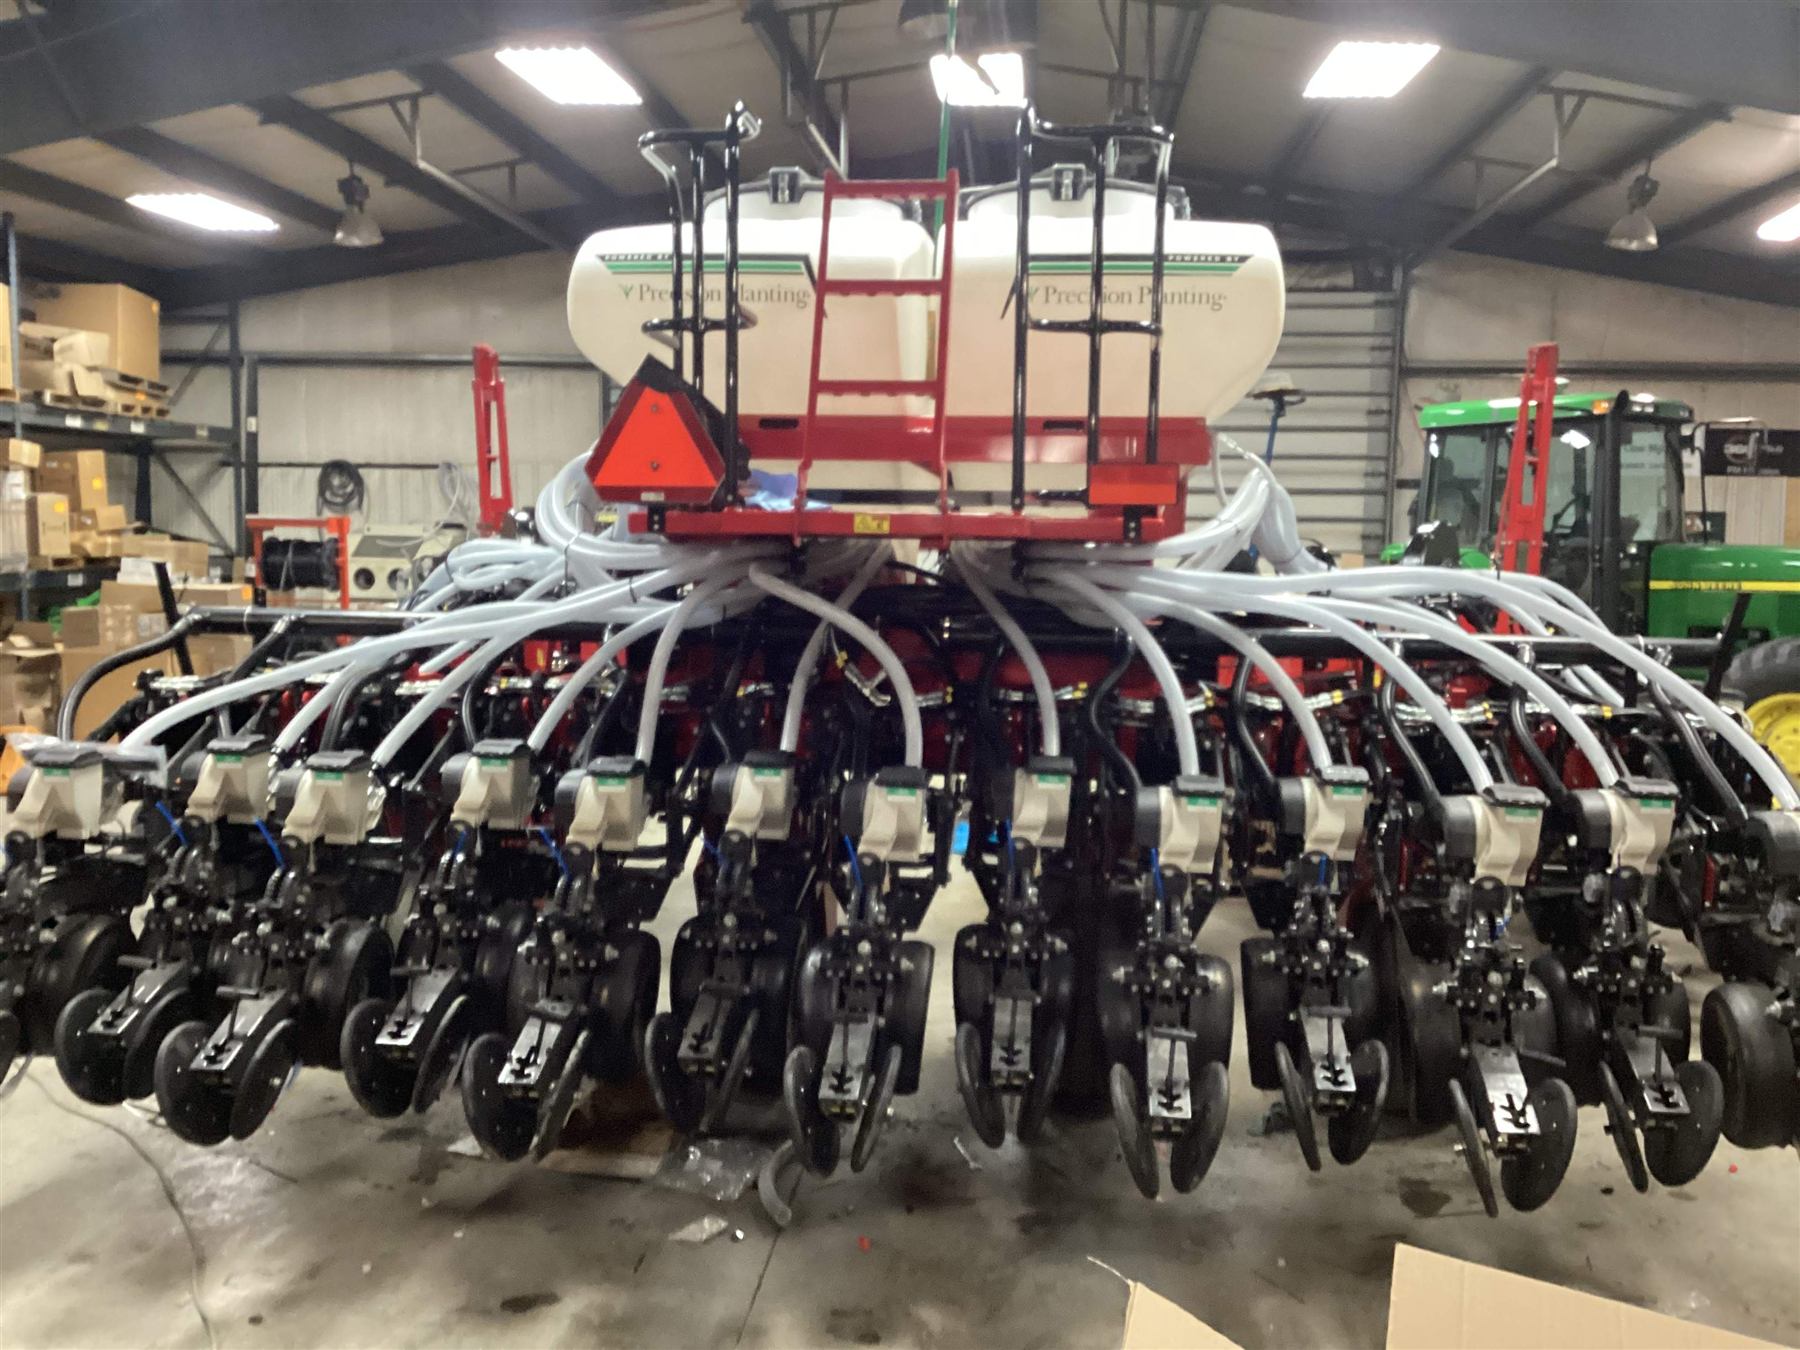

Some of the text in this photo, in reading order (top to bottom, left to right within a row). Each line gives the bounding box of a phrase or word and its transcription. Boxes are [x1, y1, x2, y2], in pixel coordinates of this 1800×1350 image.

[639, 284, 809, 309] Preson lanting
[1044, 285, 1223, 312] Precion Panting
